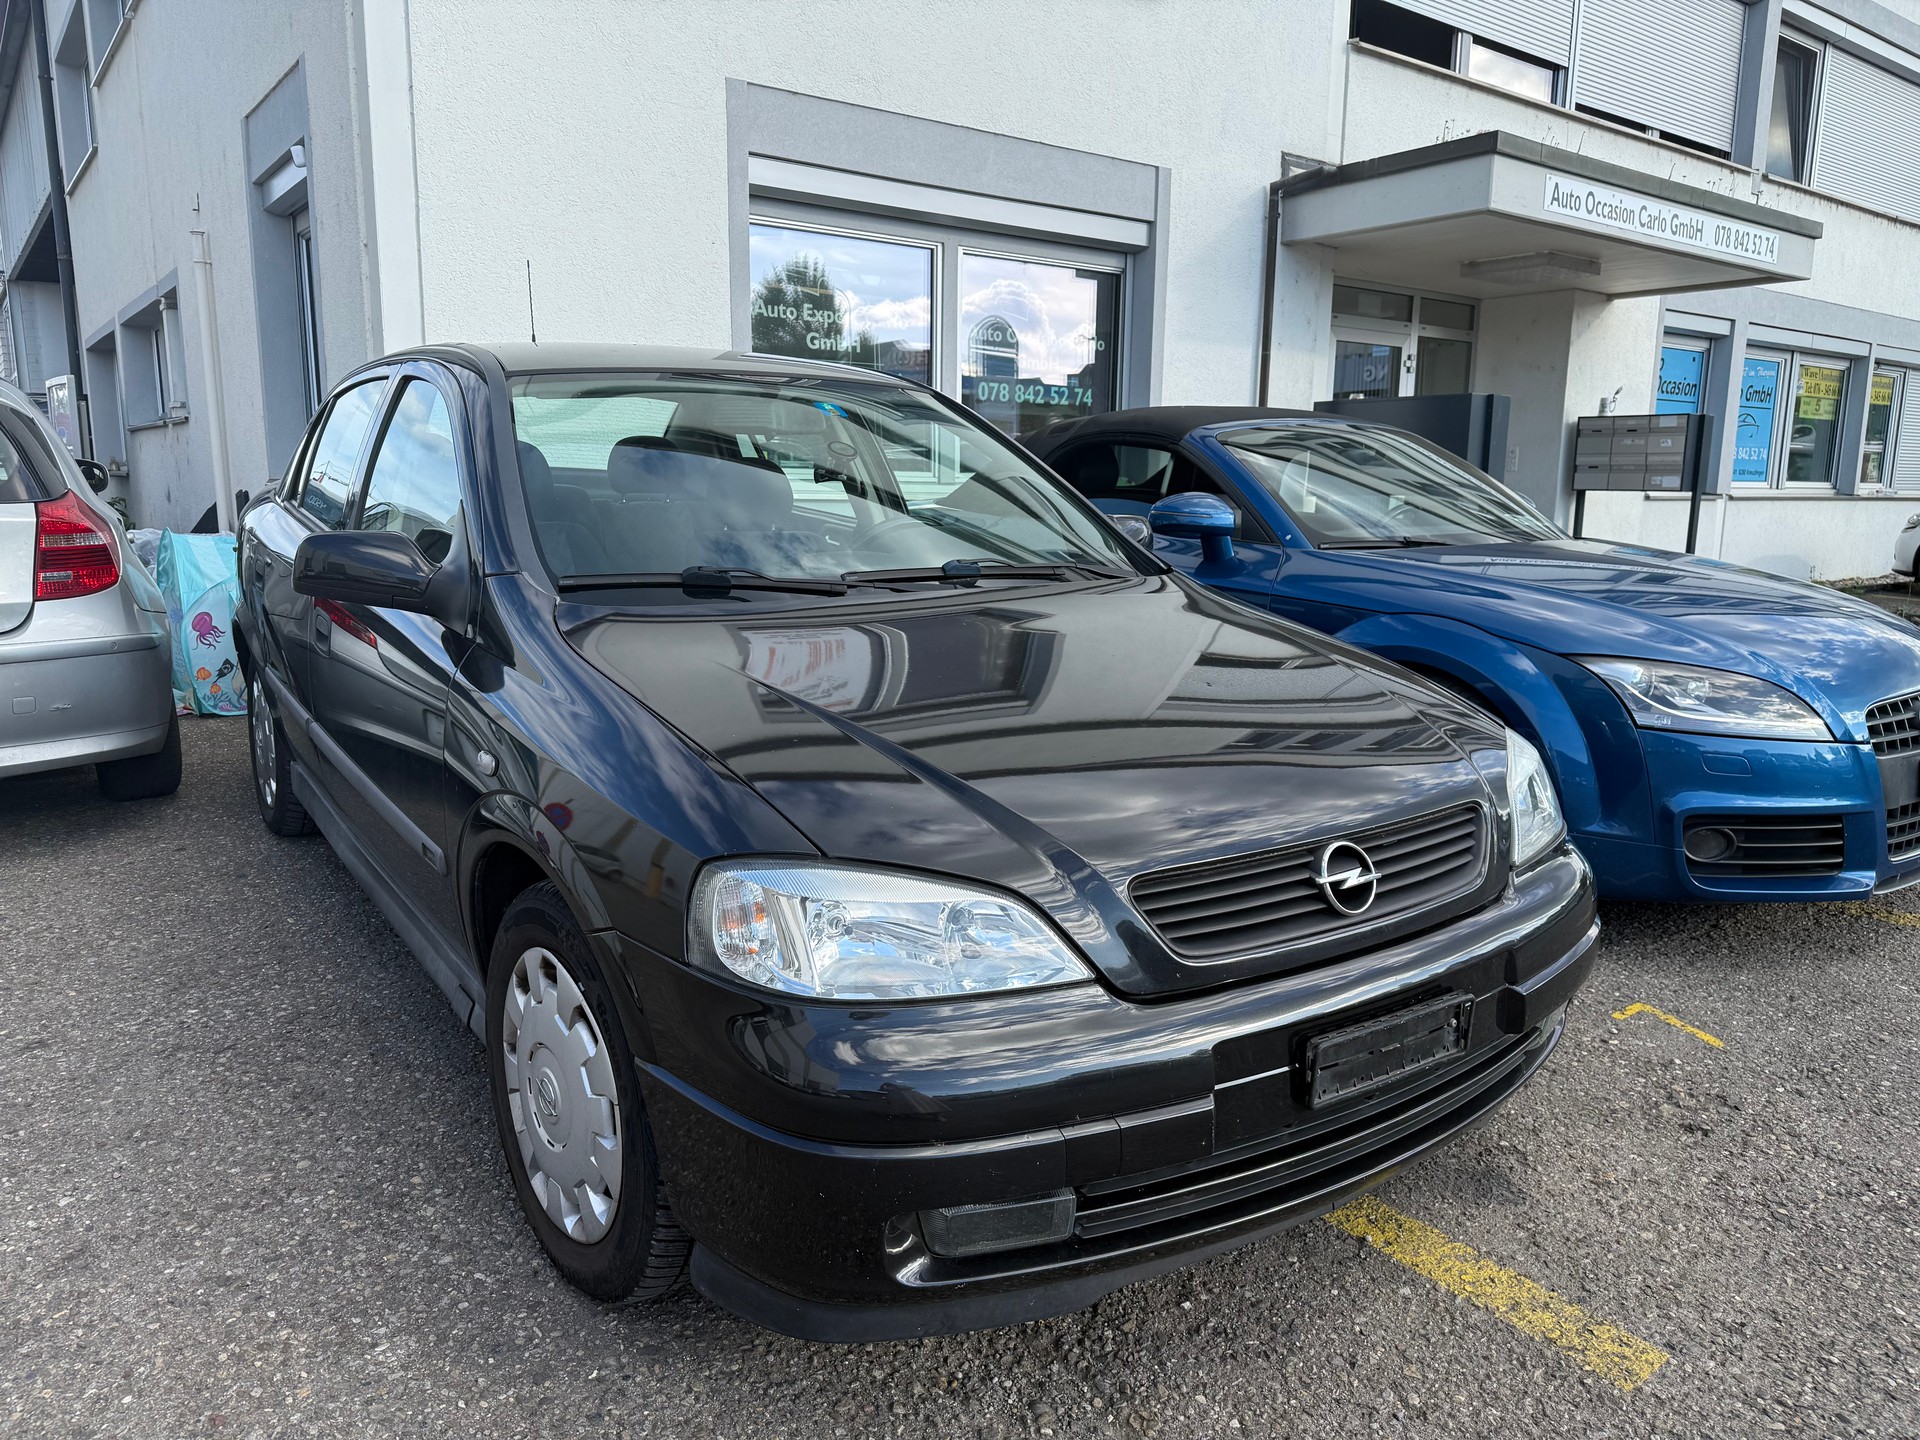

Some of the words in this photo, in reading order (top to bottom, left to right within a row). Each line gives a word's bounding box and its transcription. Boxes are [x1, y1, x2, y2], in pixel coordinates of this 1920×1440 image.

[1550, 182, 1581, 212] Auto
[1585, 191, 1635, 226] Occasion
[1638, 205, 1667, 233] Carlo
[1670, 213, 1704, 242] GmbH
[1714, 224, 1732, 248] 078
[1733, 229, 1750, 253] 842
[1751, 234, 1763, 256] 52
[1764, 235, 1777, 259] 74
[752, 299, 798, 320] Auto
[806, 331, 861, 353] GmbH
[977, 381, 1010, 403] 078
[1014, 384, 1045, 405] 842
[1049, 386, 1069, 406] 52
[1073, 387, 1093, 407] 74
[1745, 384, 1774, 404] GmbH
[1738, 447, 1750, 460] 842
[1750, 447, 1759, 460] 52
[1759, 447, 1767, 460] 74
